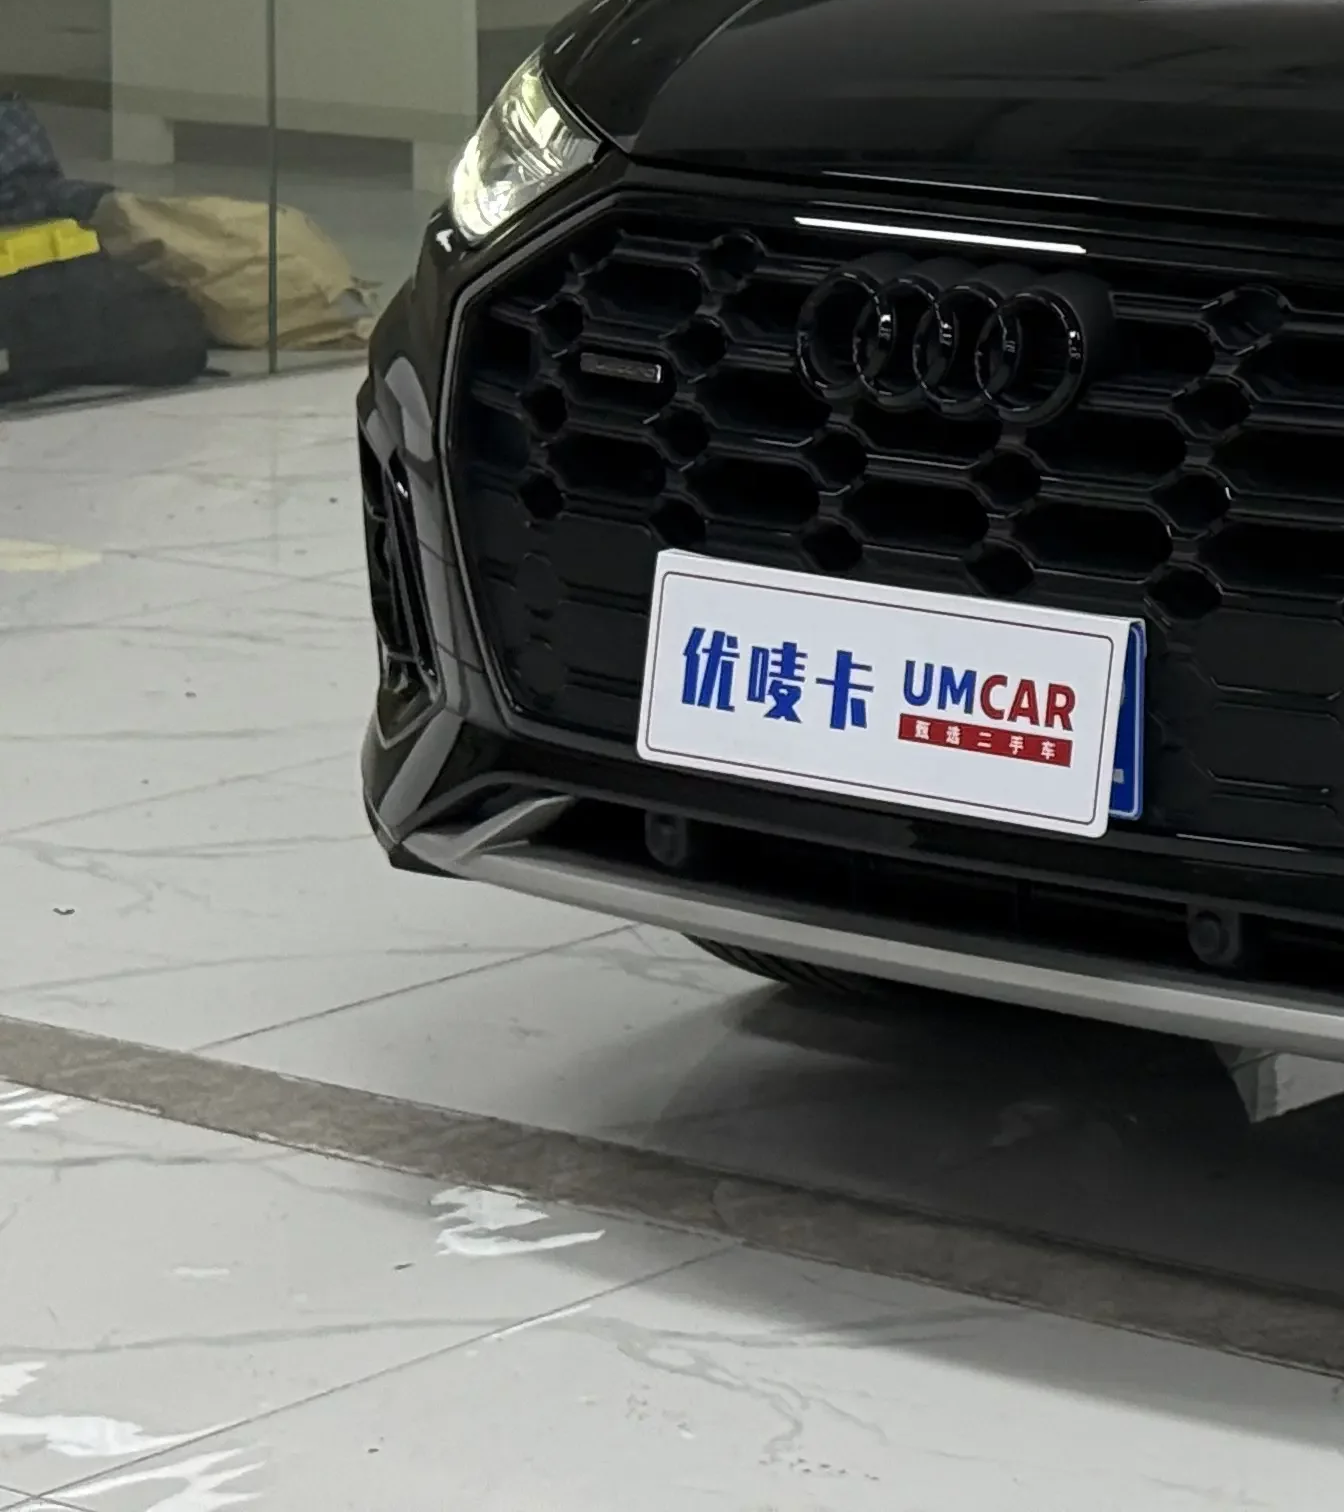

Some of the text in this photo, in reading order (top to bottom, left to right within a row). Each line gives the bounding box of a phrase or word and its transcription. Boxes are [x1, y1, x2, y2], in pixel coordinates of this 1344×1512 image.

[681, 627, 874, 730] 优唛卡
[903, 659, 1076, 731] UMCAR
